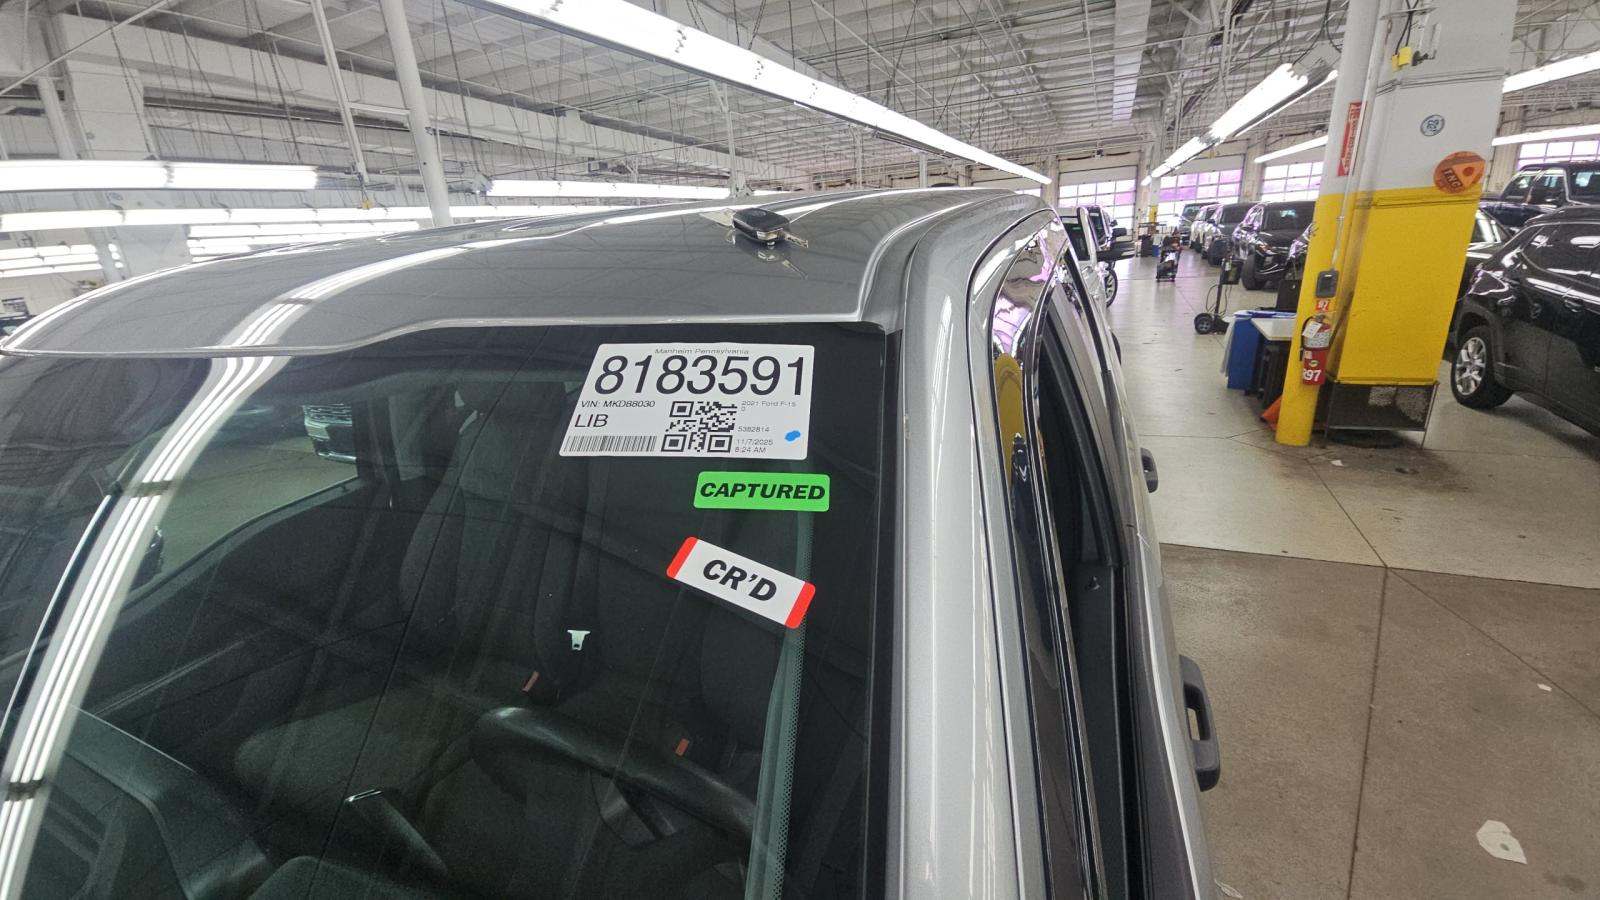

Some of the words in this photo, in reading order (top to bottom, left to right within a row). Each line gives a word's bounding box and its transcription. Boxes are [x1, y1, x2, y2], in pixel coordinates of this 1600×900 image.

[694, 348, 749, 356] Pennsylvania
[594, 354, 805, 396] 8183591
[581, 400, 600, 408] VIN:
[603, 400, 656, 408] MKD88030
[574, 413, 609, 428] LIB
[736, 438, 774, 446] 11/7/2025
[753, 446, 767, 454] AM
[700, 482, 826, 501] CAPTURED
[702, 559, 778, 602] CR'D
